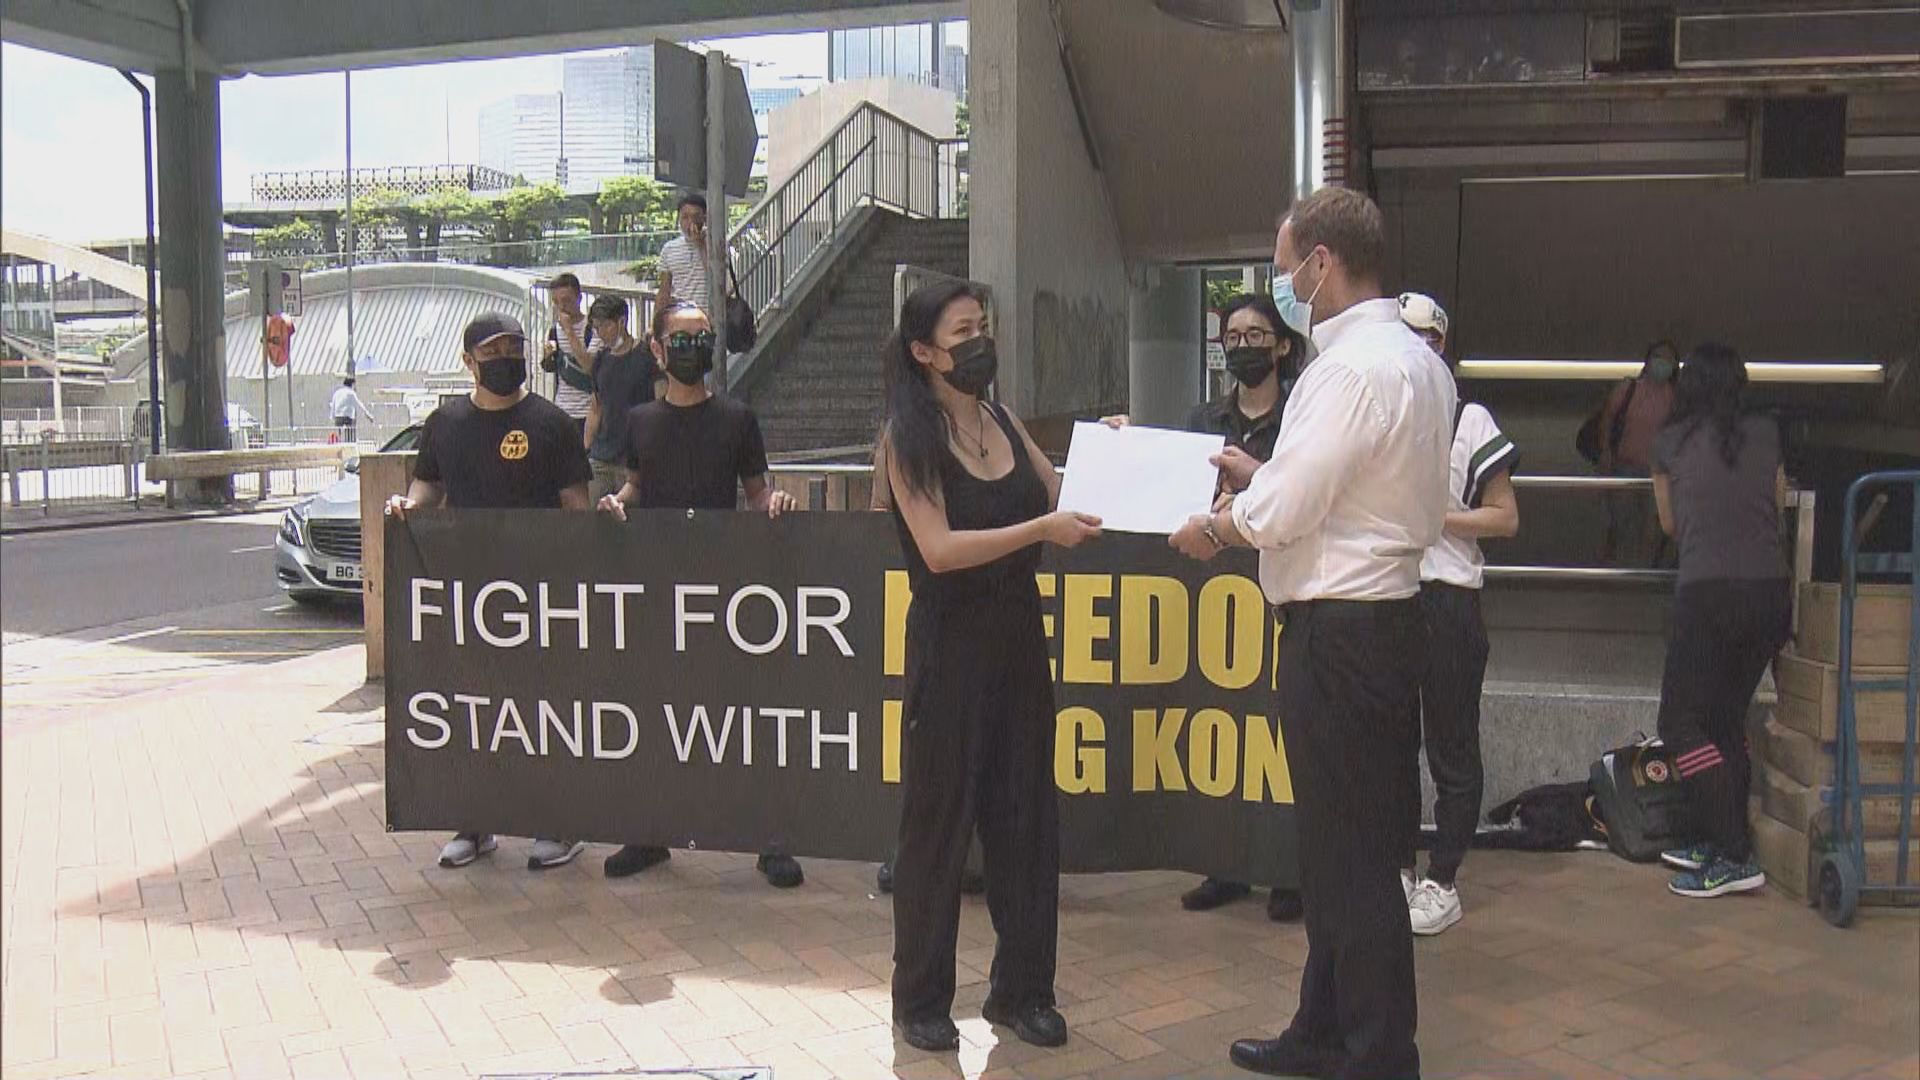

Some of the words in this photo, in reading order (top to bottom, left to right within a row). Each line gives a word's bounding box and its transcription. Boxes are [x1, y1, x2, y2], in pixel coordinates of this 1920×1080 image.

[335, 565, 354, 578] BG
[409, 577, 646, 651] FIGHT
[673, 584, 855, 657] FOR
[405, 691, 640, 760] STAND
[663, 704, 859, 771] WITH
[1132, 707, 1295, 804] KON
